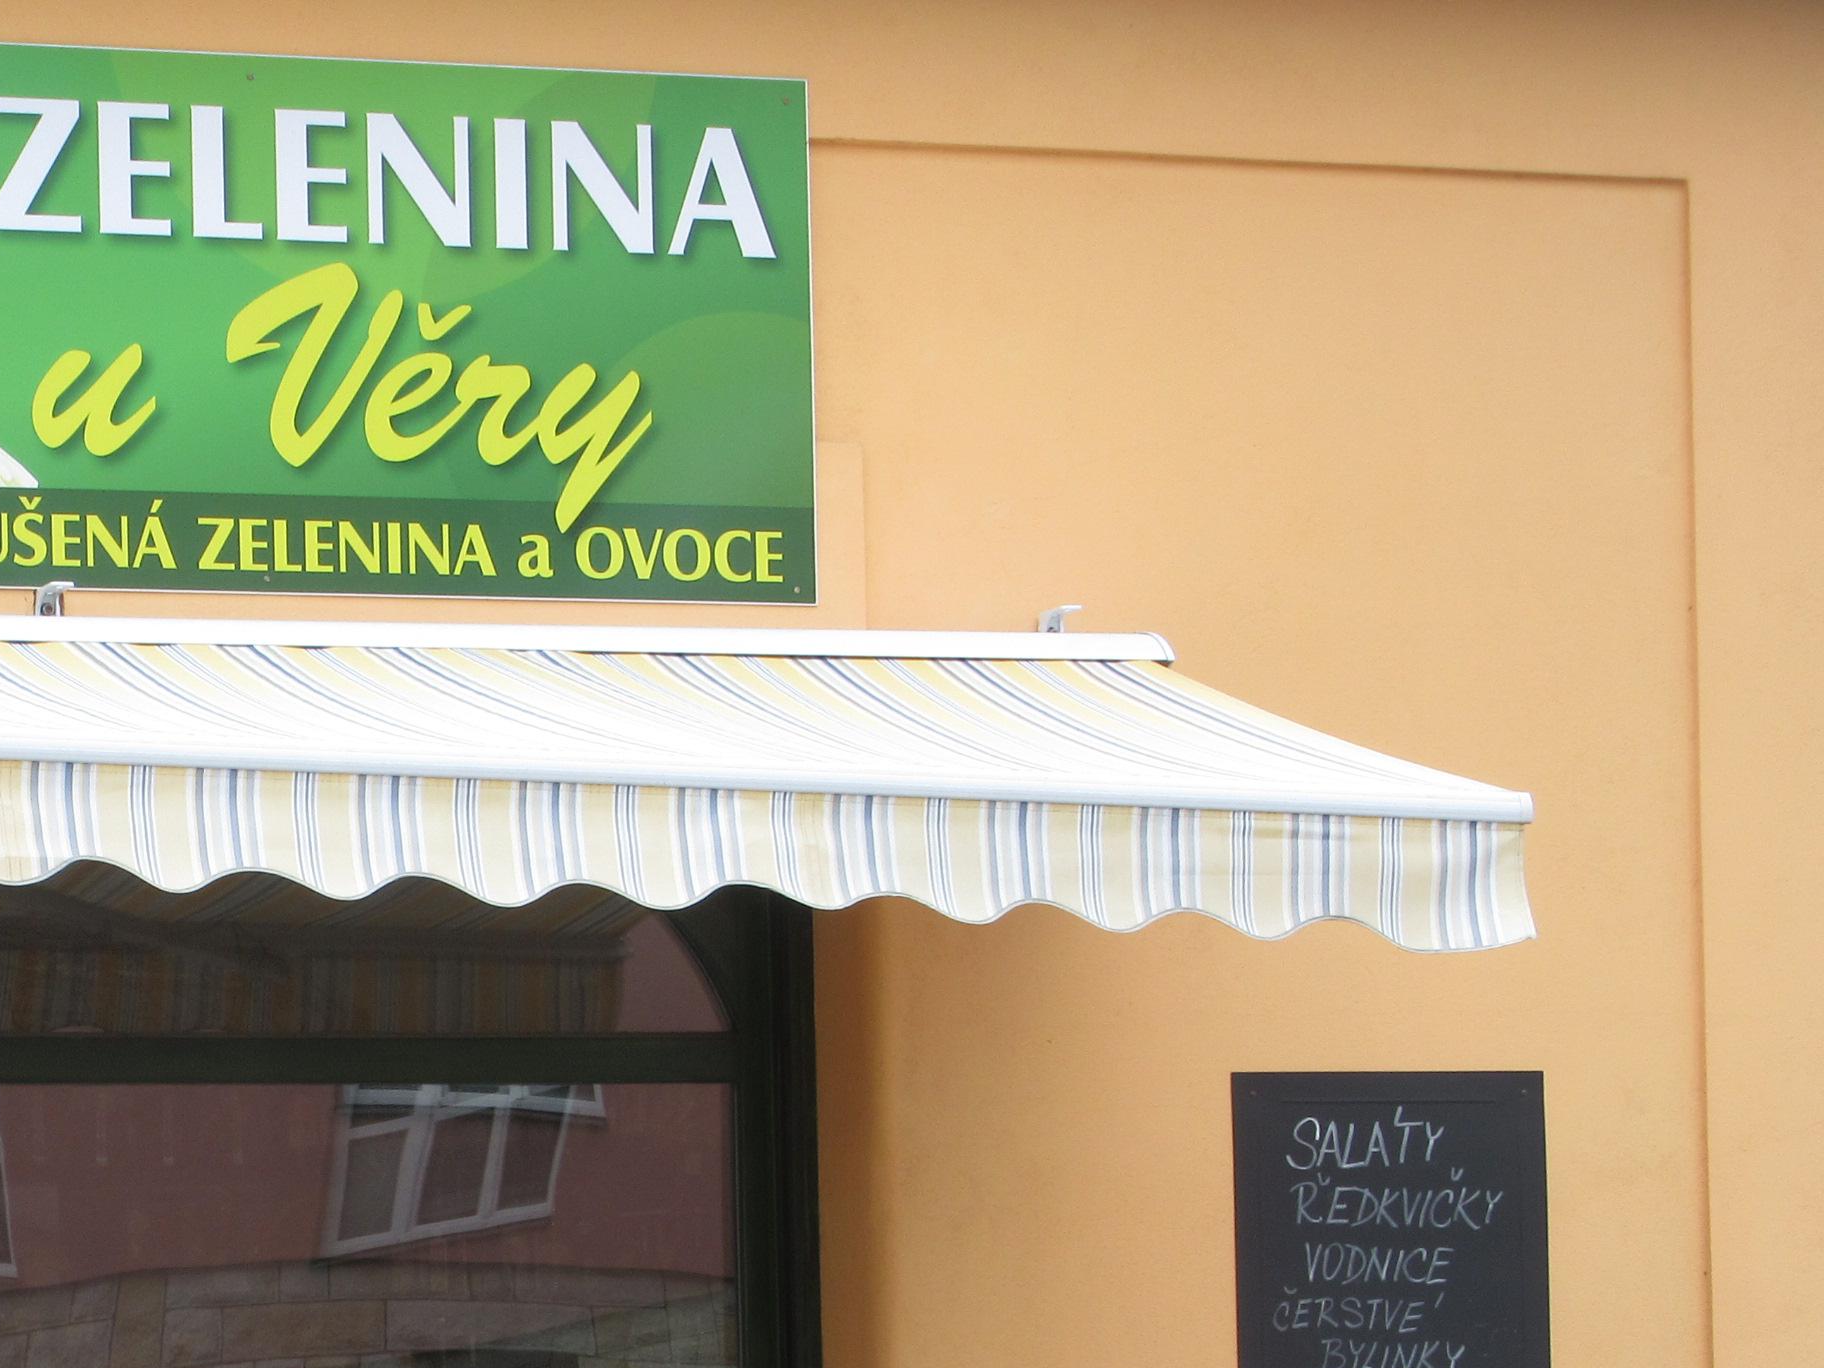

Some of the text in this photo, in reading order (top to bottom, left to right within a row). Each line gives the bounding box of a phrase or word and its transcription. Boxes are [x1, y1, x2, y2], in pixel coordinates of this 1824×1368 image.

[32, 262, 652, 534] u Věry
[197, 517, 495, 577] ZELENINA
[518, 534, 554, 580] a
[575, 528, 784, 585] OVOCE
[1289, 1167, 1504, 1231] ŘEDKVIČKY
[1305, 1242, 1456, 1285] VODNICE
[1272, 1286, 1445, 1333] ČERSTVÉ
